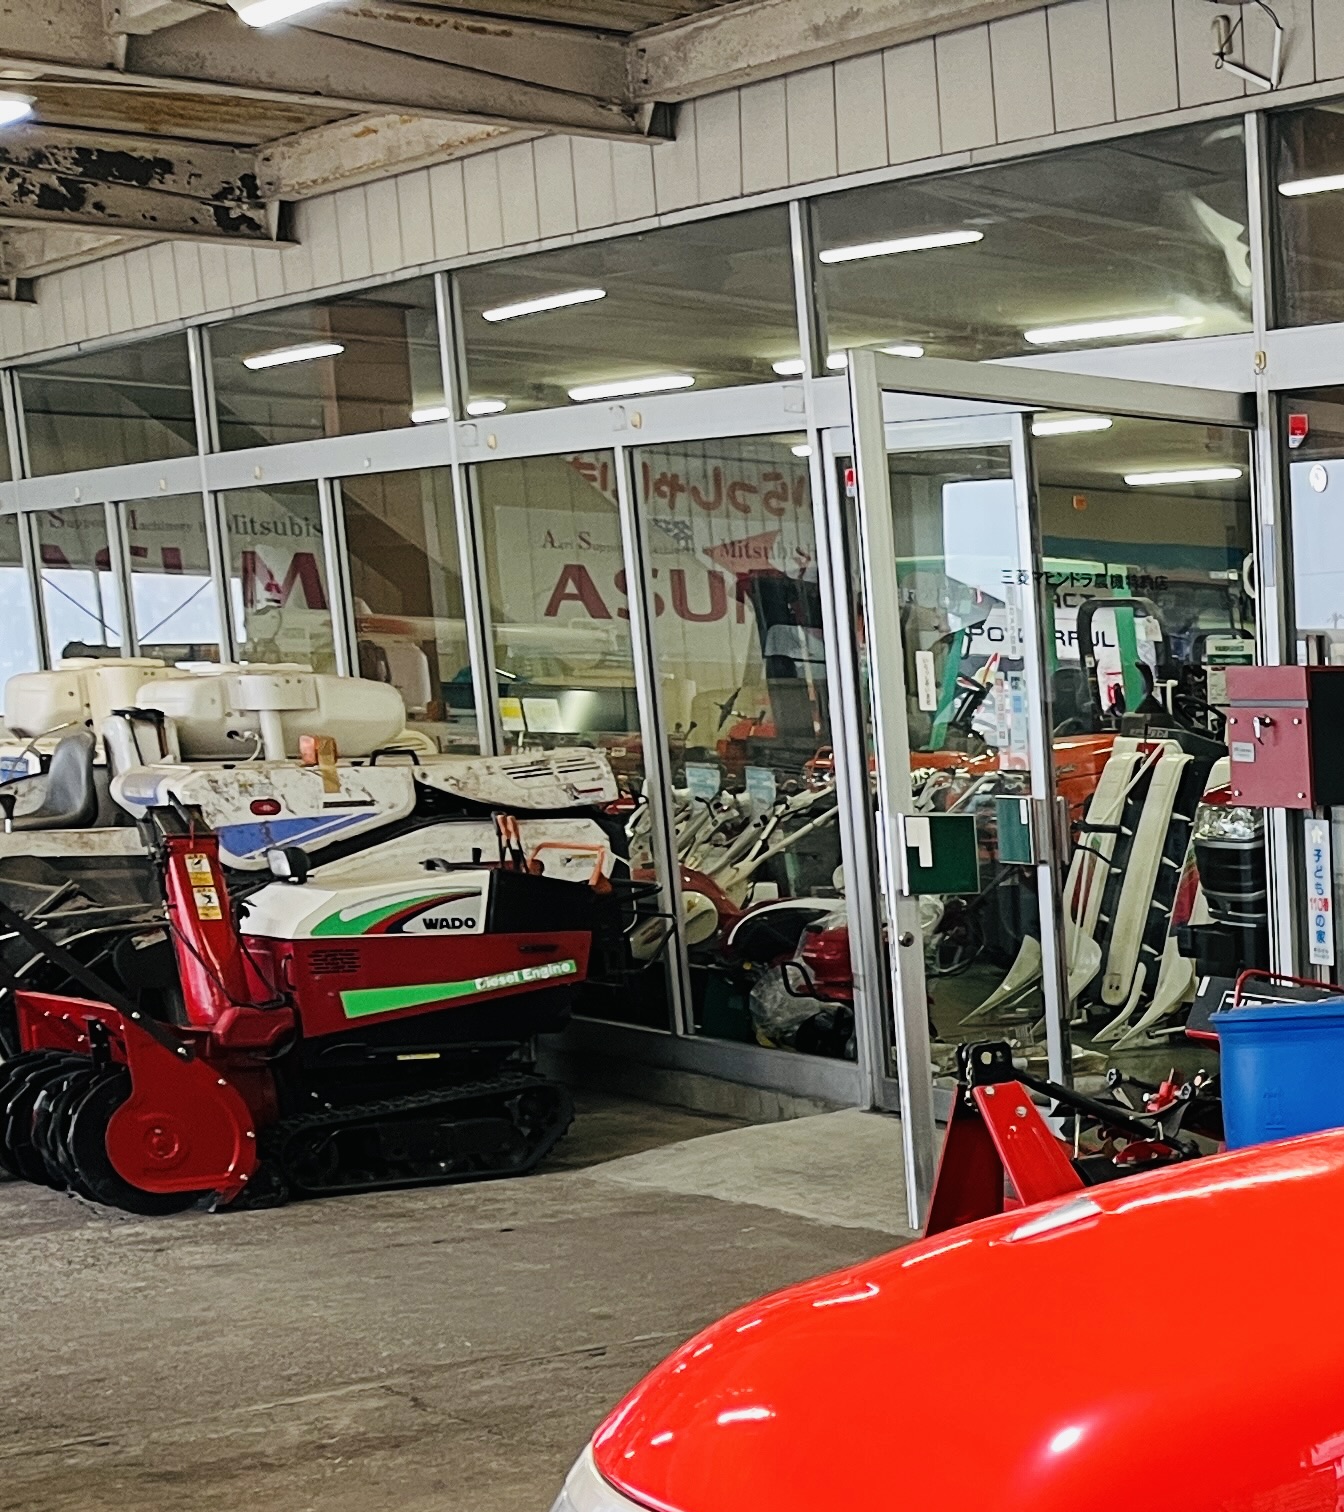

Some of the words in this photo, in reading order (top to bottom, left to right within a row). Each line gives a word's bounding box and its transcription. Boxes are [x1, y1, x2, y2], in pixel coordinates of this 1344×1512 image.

[422, 917, 477, 931] WADO
[475, 969, 521, 991] Diesel
[522, 961, 572, 983] Engine
